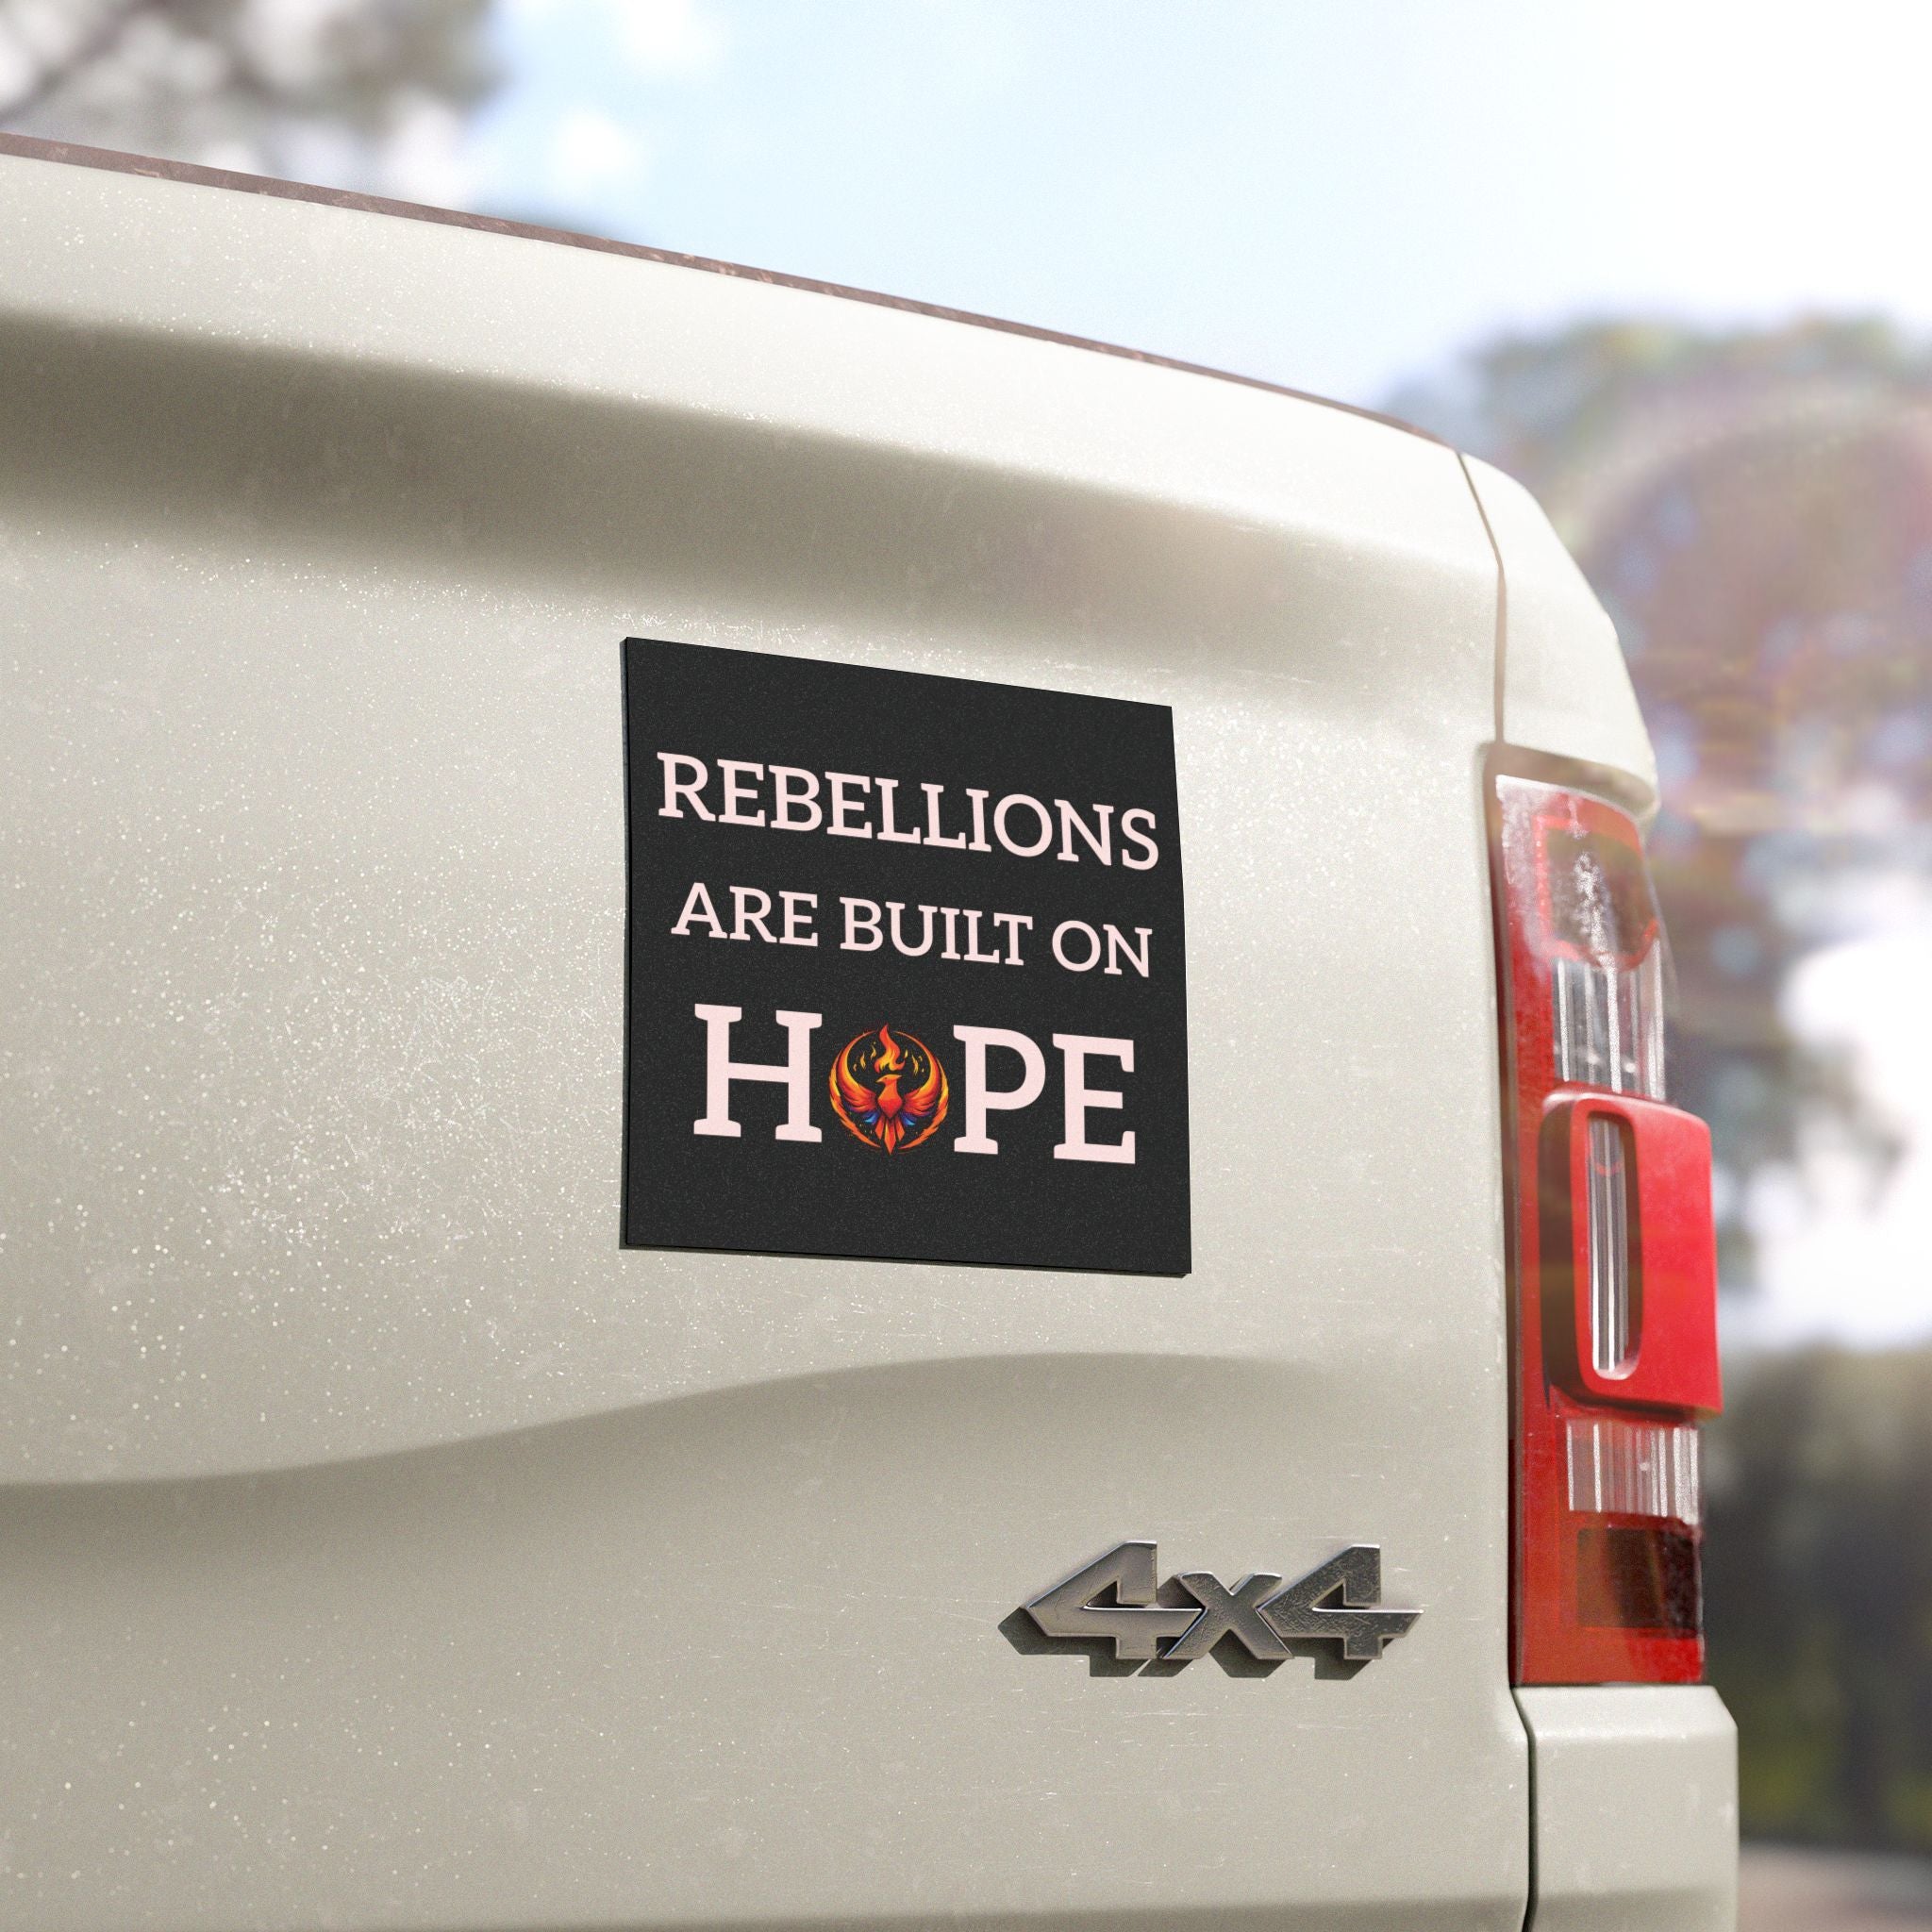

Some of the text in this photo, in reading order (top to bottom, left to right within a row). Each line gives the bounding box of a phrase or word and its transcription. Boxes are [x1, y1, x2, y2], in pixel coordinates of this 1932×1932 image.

[657, 751, 1160, 871] REBELLIONS
[670, 882, 1153, 978] ARE BUILT ON
[1023, 1540, 1424, 1660] 4x4
